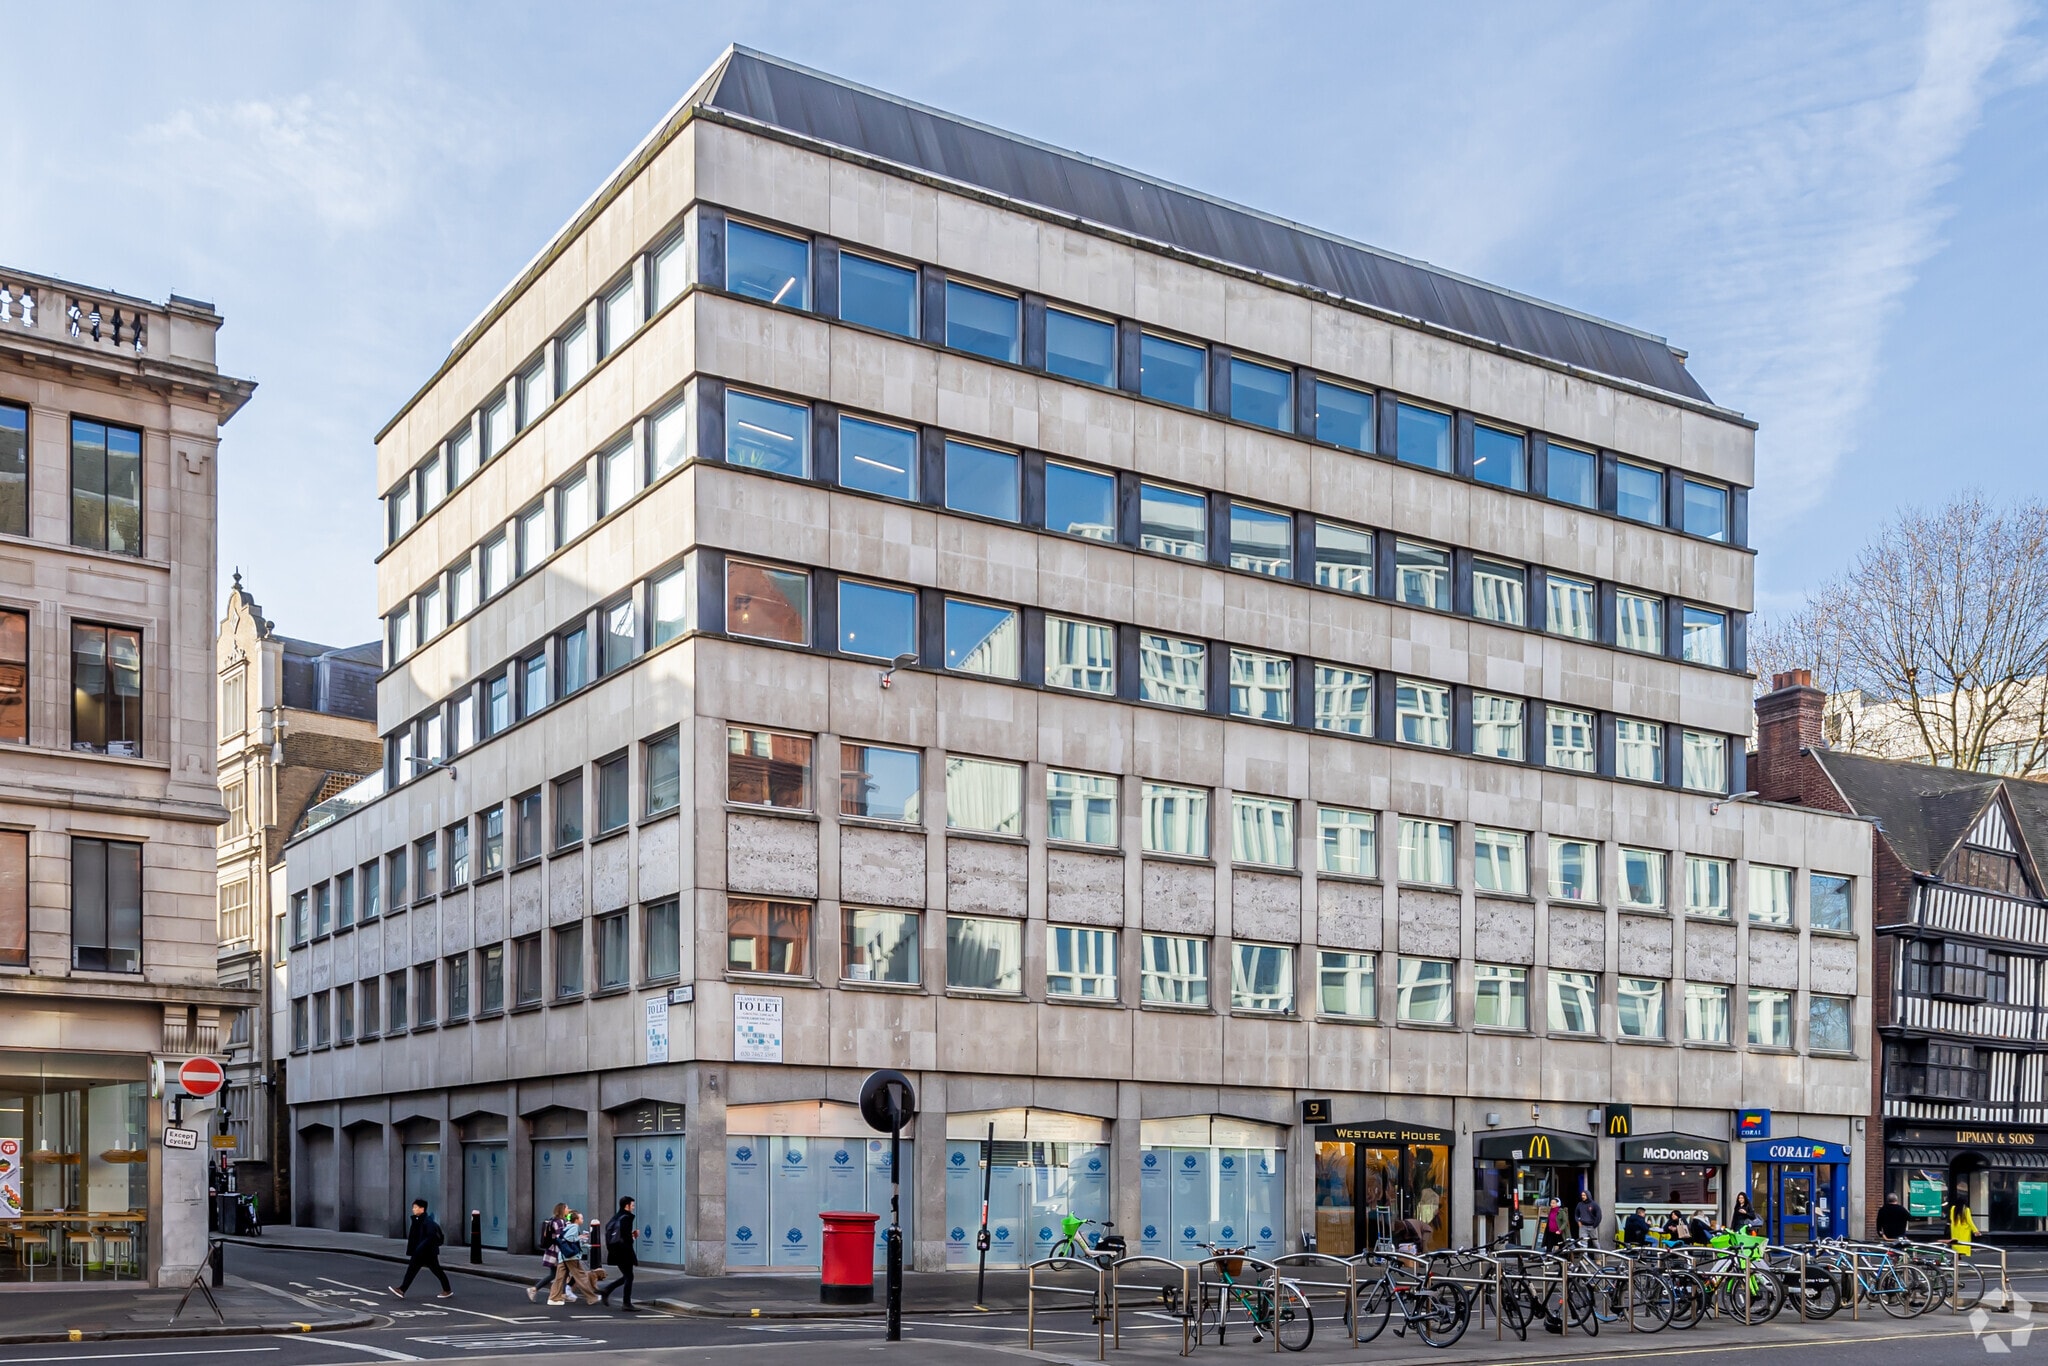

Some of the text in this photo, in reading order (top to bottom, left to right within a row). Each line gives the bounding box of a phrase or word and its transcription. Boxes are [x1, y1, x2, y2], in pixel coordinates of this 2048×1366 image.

[647, 1003, 667, 1015] TO LET
[736, 1001, 781, 1013] TO LET
[1310, 1103, 1319, 1115] 9
[169, 1131, 194, 1140] Except
[1336, 1128, 1441, 1141] WESTGATE HOUSE
[1956, 1131, 2035, 1145] LIPMAN & SONS
[169, 1138, 192, 1146] cycles
[1643, 1147, 1709, 1161] McDonald's
[1769, 1145, 1812, 1158] CORAL
